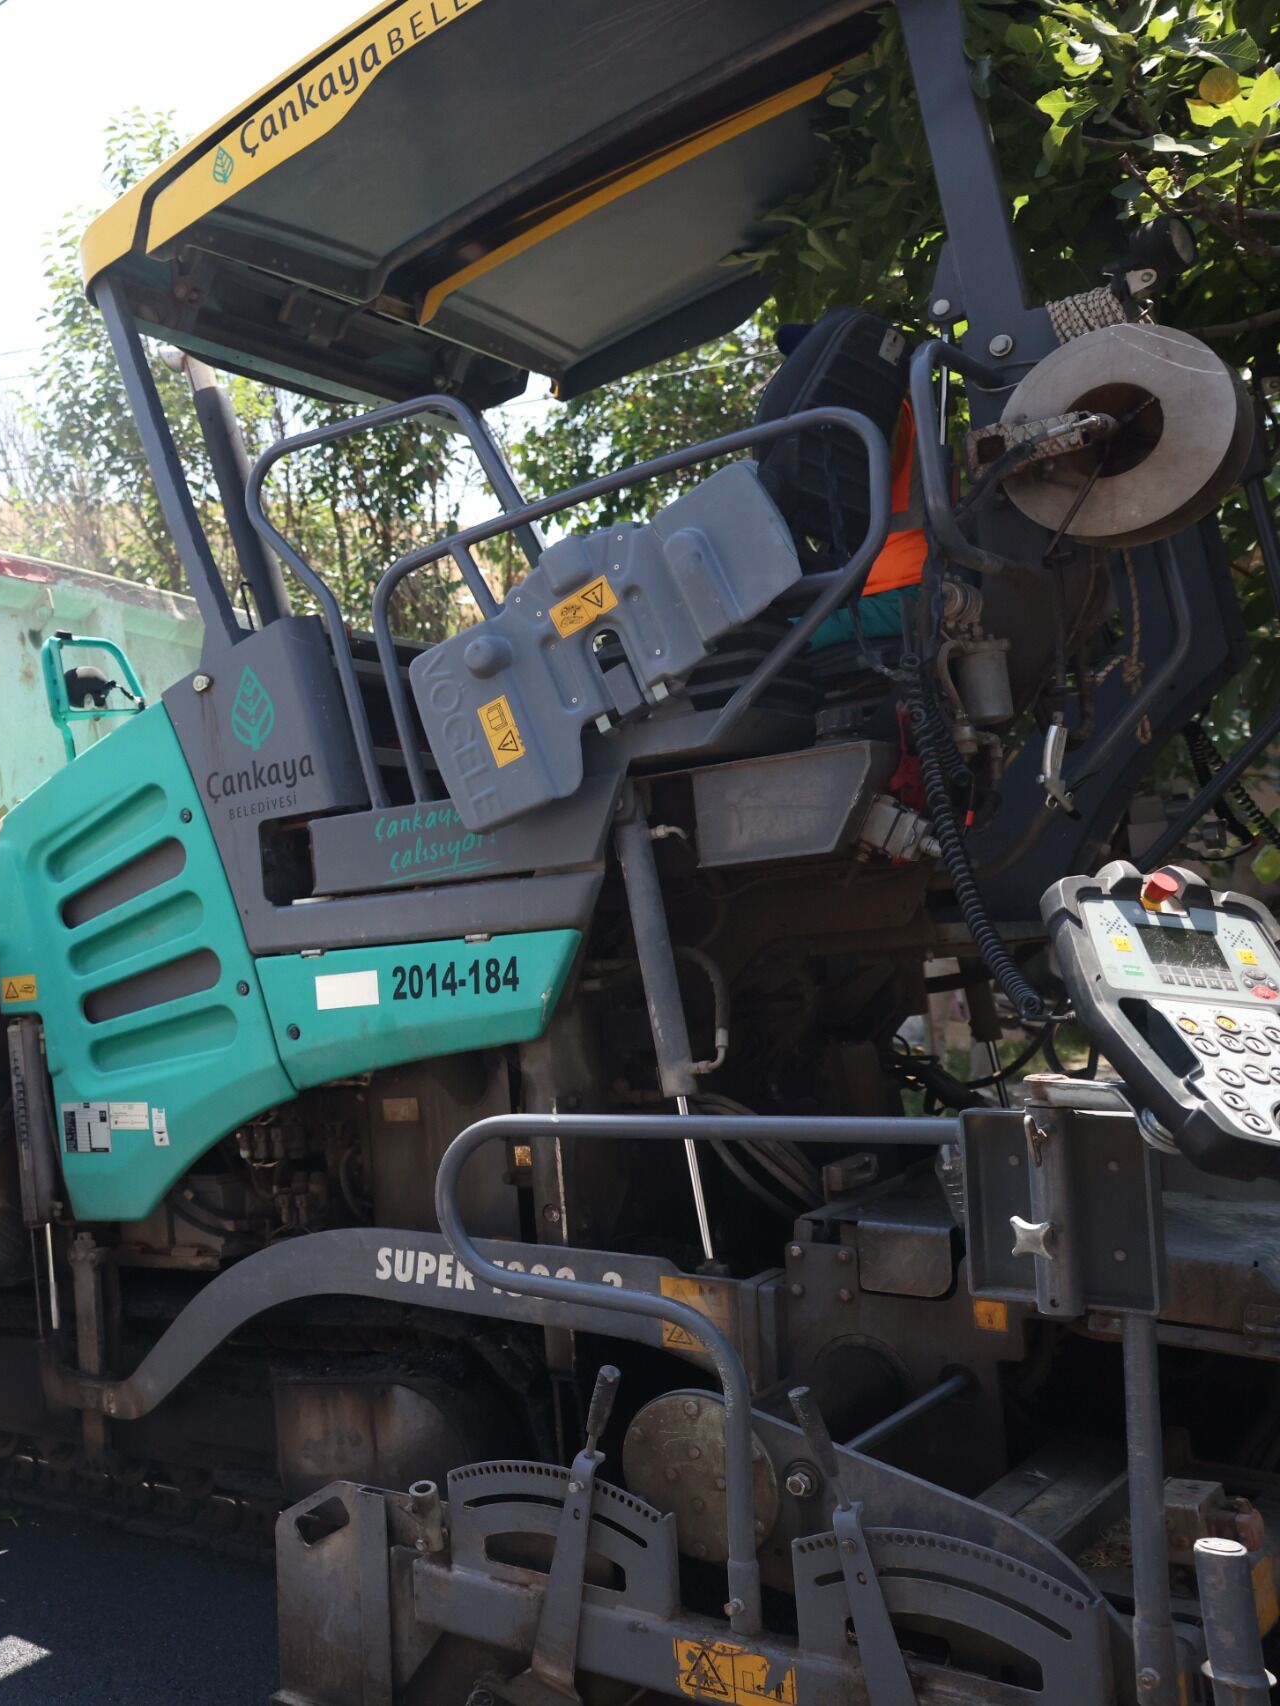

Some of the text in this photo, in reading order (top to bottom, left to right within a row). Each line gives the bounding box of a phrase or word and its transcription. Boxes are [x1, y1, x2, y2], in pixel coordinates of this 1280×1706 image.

[239, 42, 382, 158] Çankaya
[422, 650, 504, 822] VÖGELE
[206, 753, 315, 804] Çankaya
[228, 791, 297, 820] BELEDİYESİ
[392, 955, 520, 1001] 2014-184
[375, 1246, 476, 1292] SUPER
